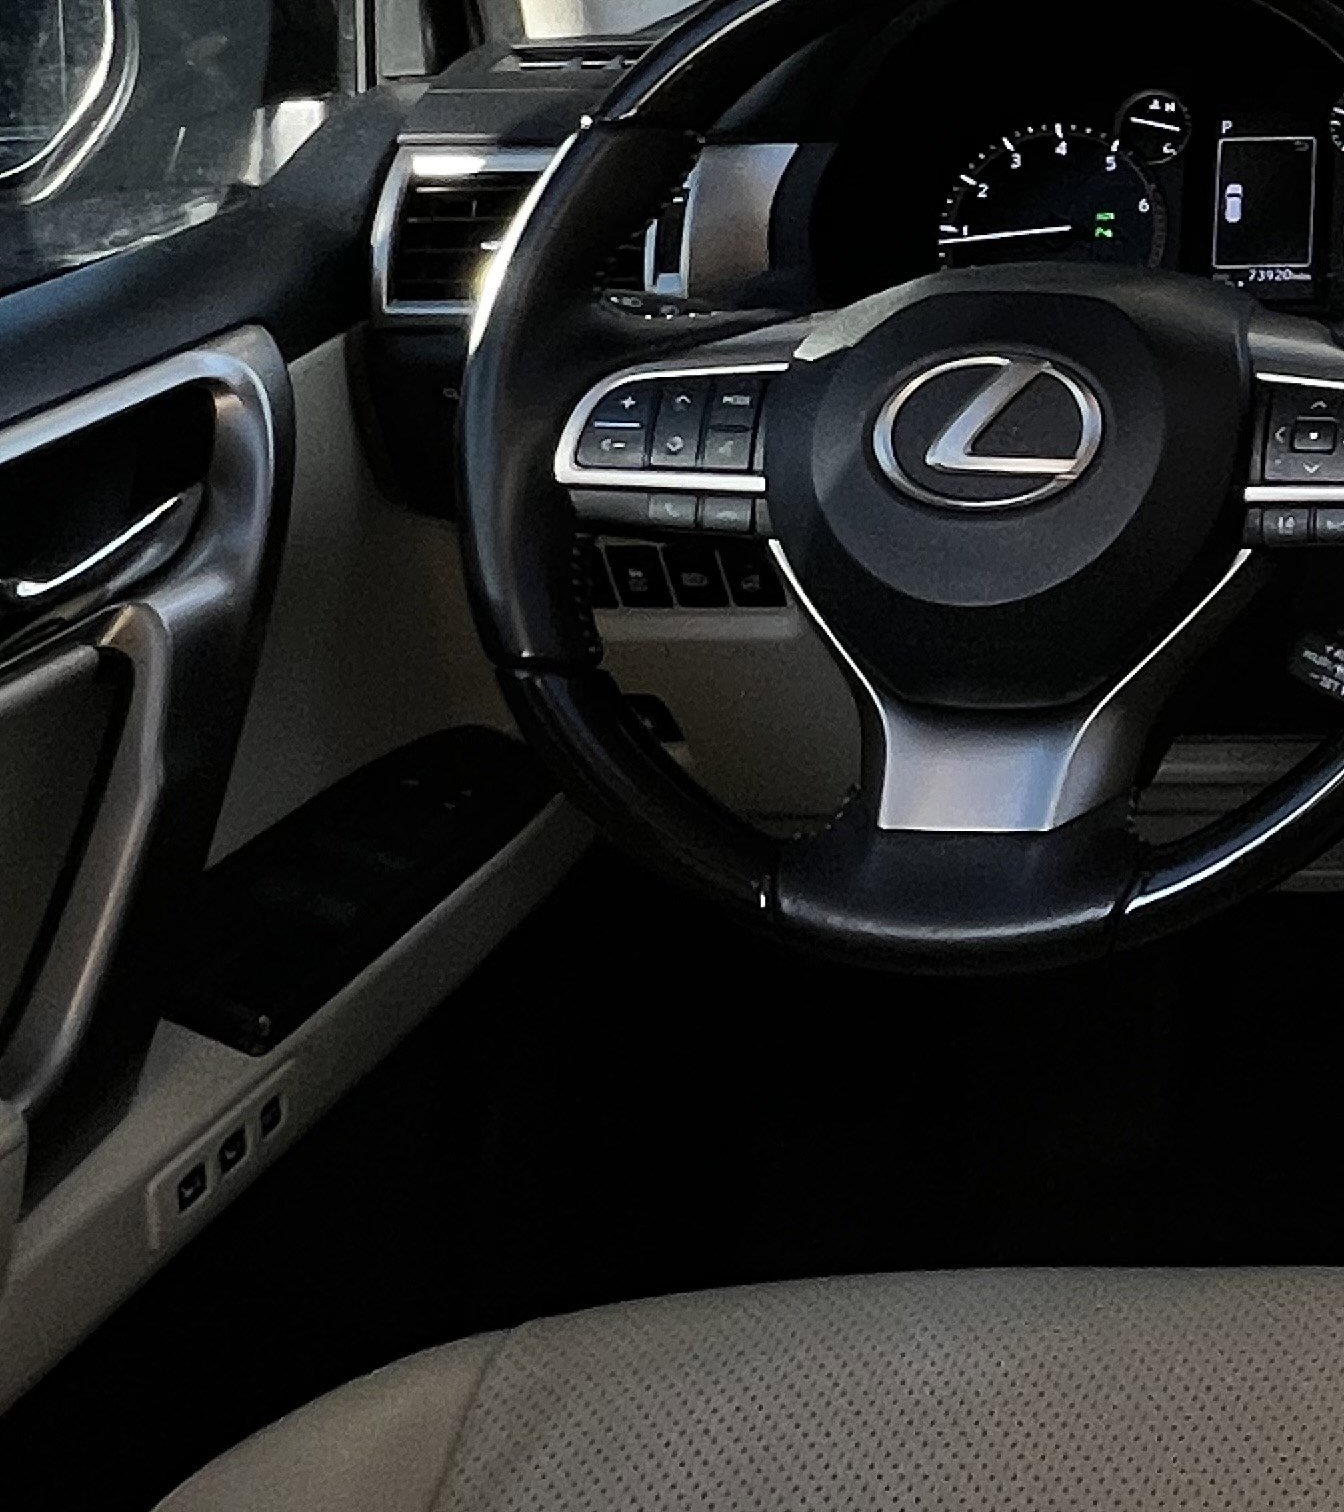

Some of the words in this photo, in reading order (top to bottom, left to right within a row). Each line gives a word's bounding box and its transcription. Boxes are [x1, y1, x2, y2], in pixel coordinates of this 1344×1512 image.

[1221, 120, 1232, 134] P
[1054, 140, 1068, 156] 4
[1010, 152, 1022, 170] 3
[1105, 155, 1117, 172] 5
[976, 183, 989, 198] 2
[1138, 198, 1150, 213] 6
